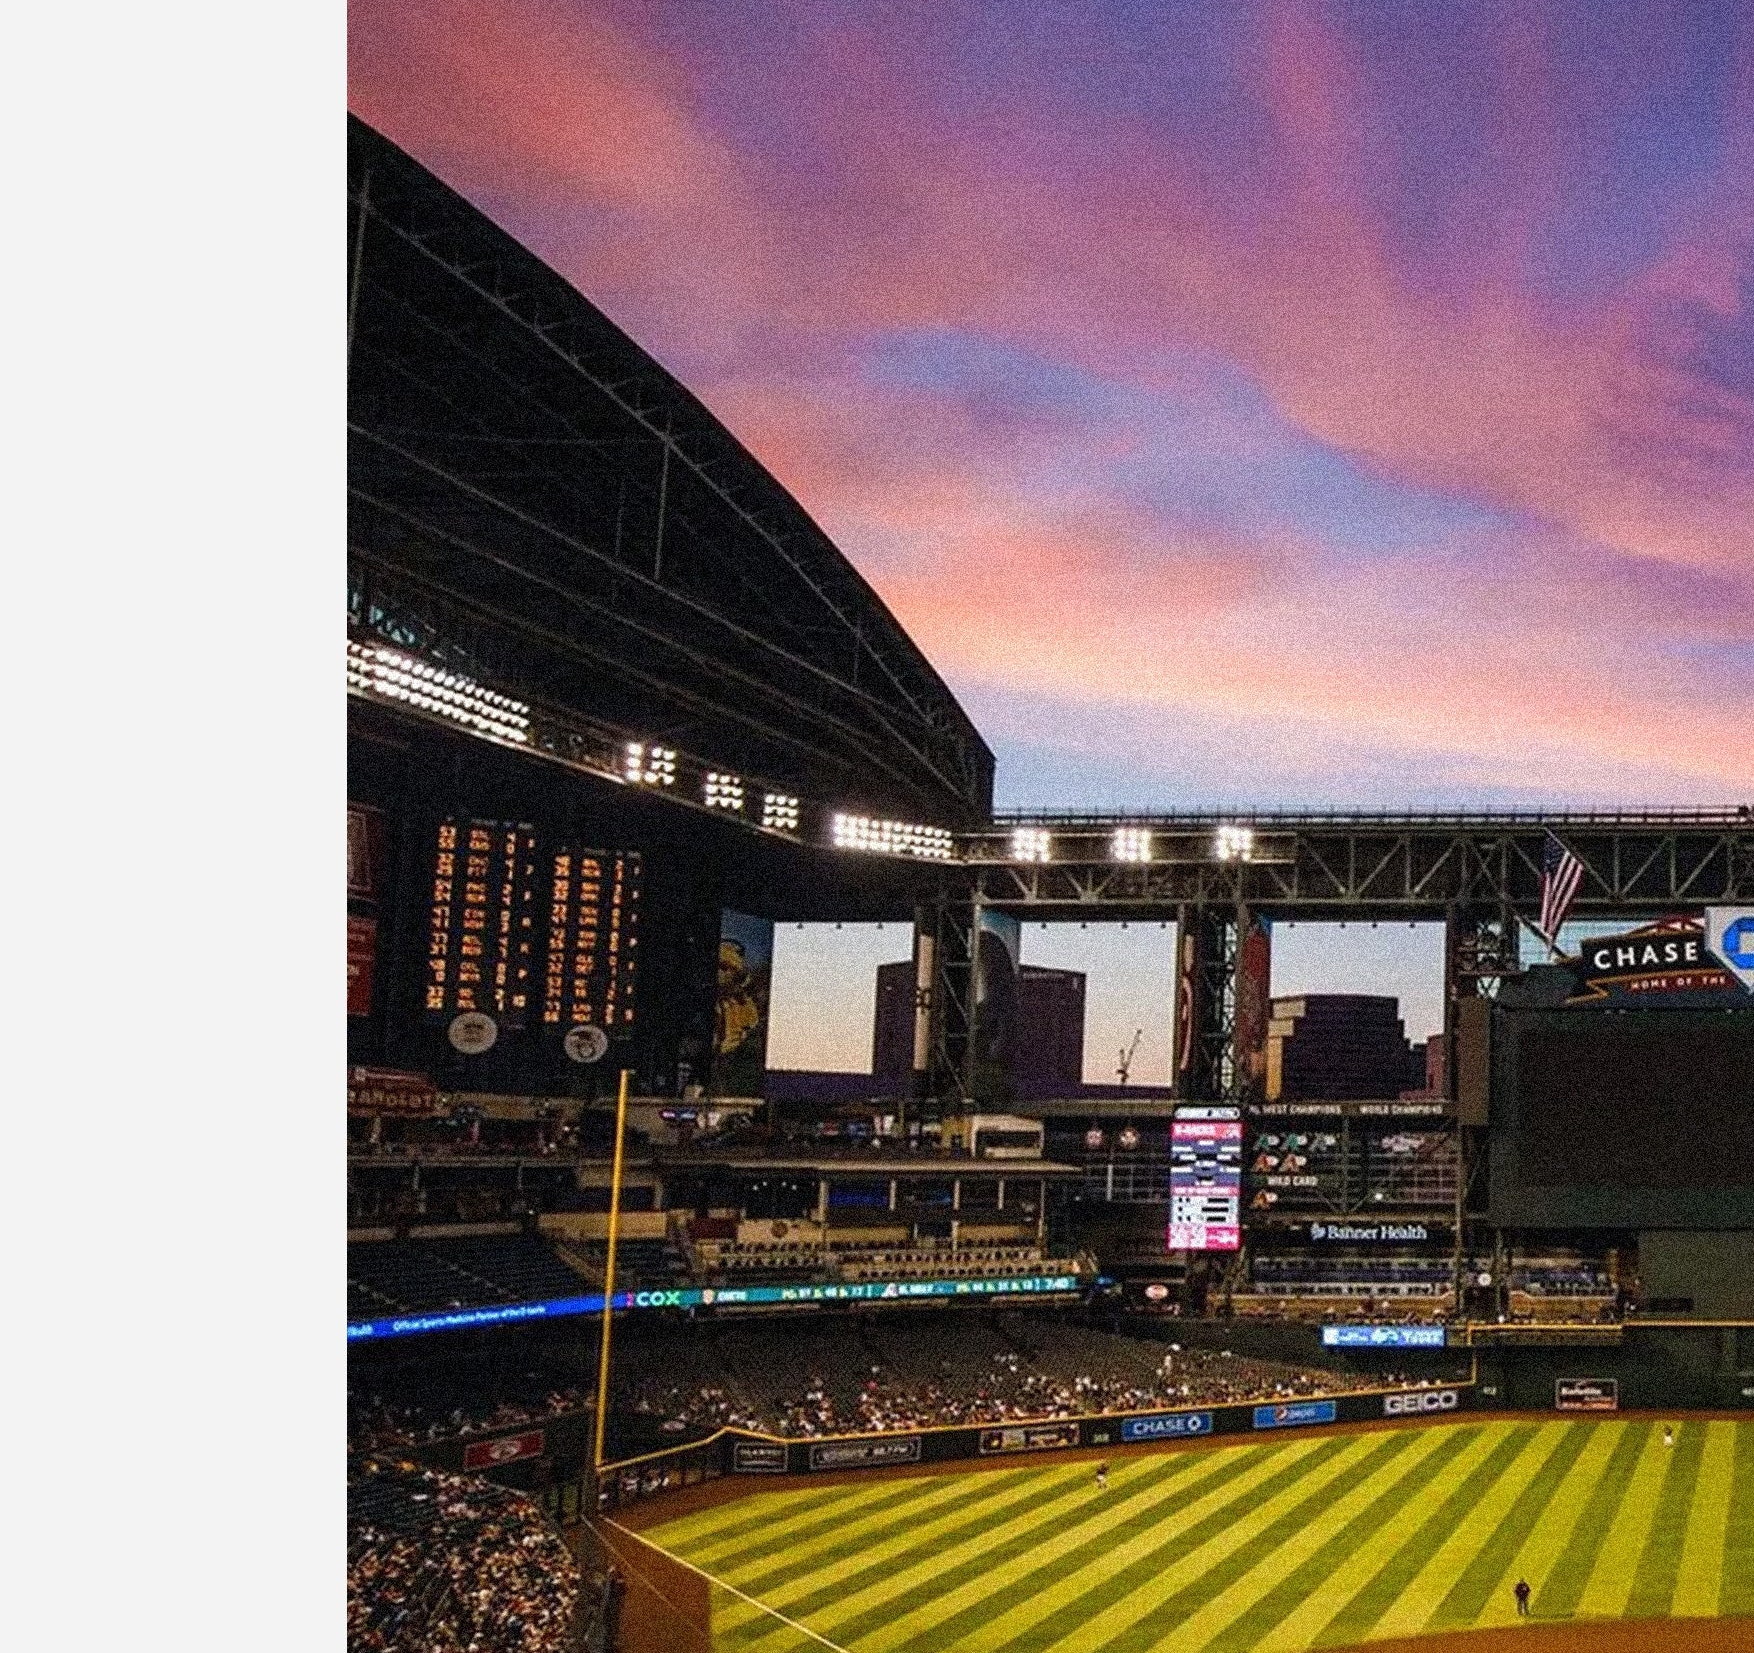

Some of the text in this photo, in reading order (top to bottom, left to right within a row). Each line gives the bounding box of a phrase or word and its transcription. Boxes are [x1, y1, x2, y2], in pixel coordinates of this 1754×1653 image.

[1593, 941, 1700, 971] CHASE
[1630, 978, 1668, 991] HOME
[1676, 976, 1692, 988] OF
[1701, 975, 1727, 986] THE
[1327, 1226, 1428, 1240] Banner Health
[636, 1290, 681, 1306] COX
[1384, 1391, 1458, 1415] GEICO
[1133, 1420, 1184, 1435] CHASE
